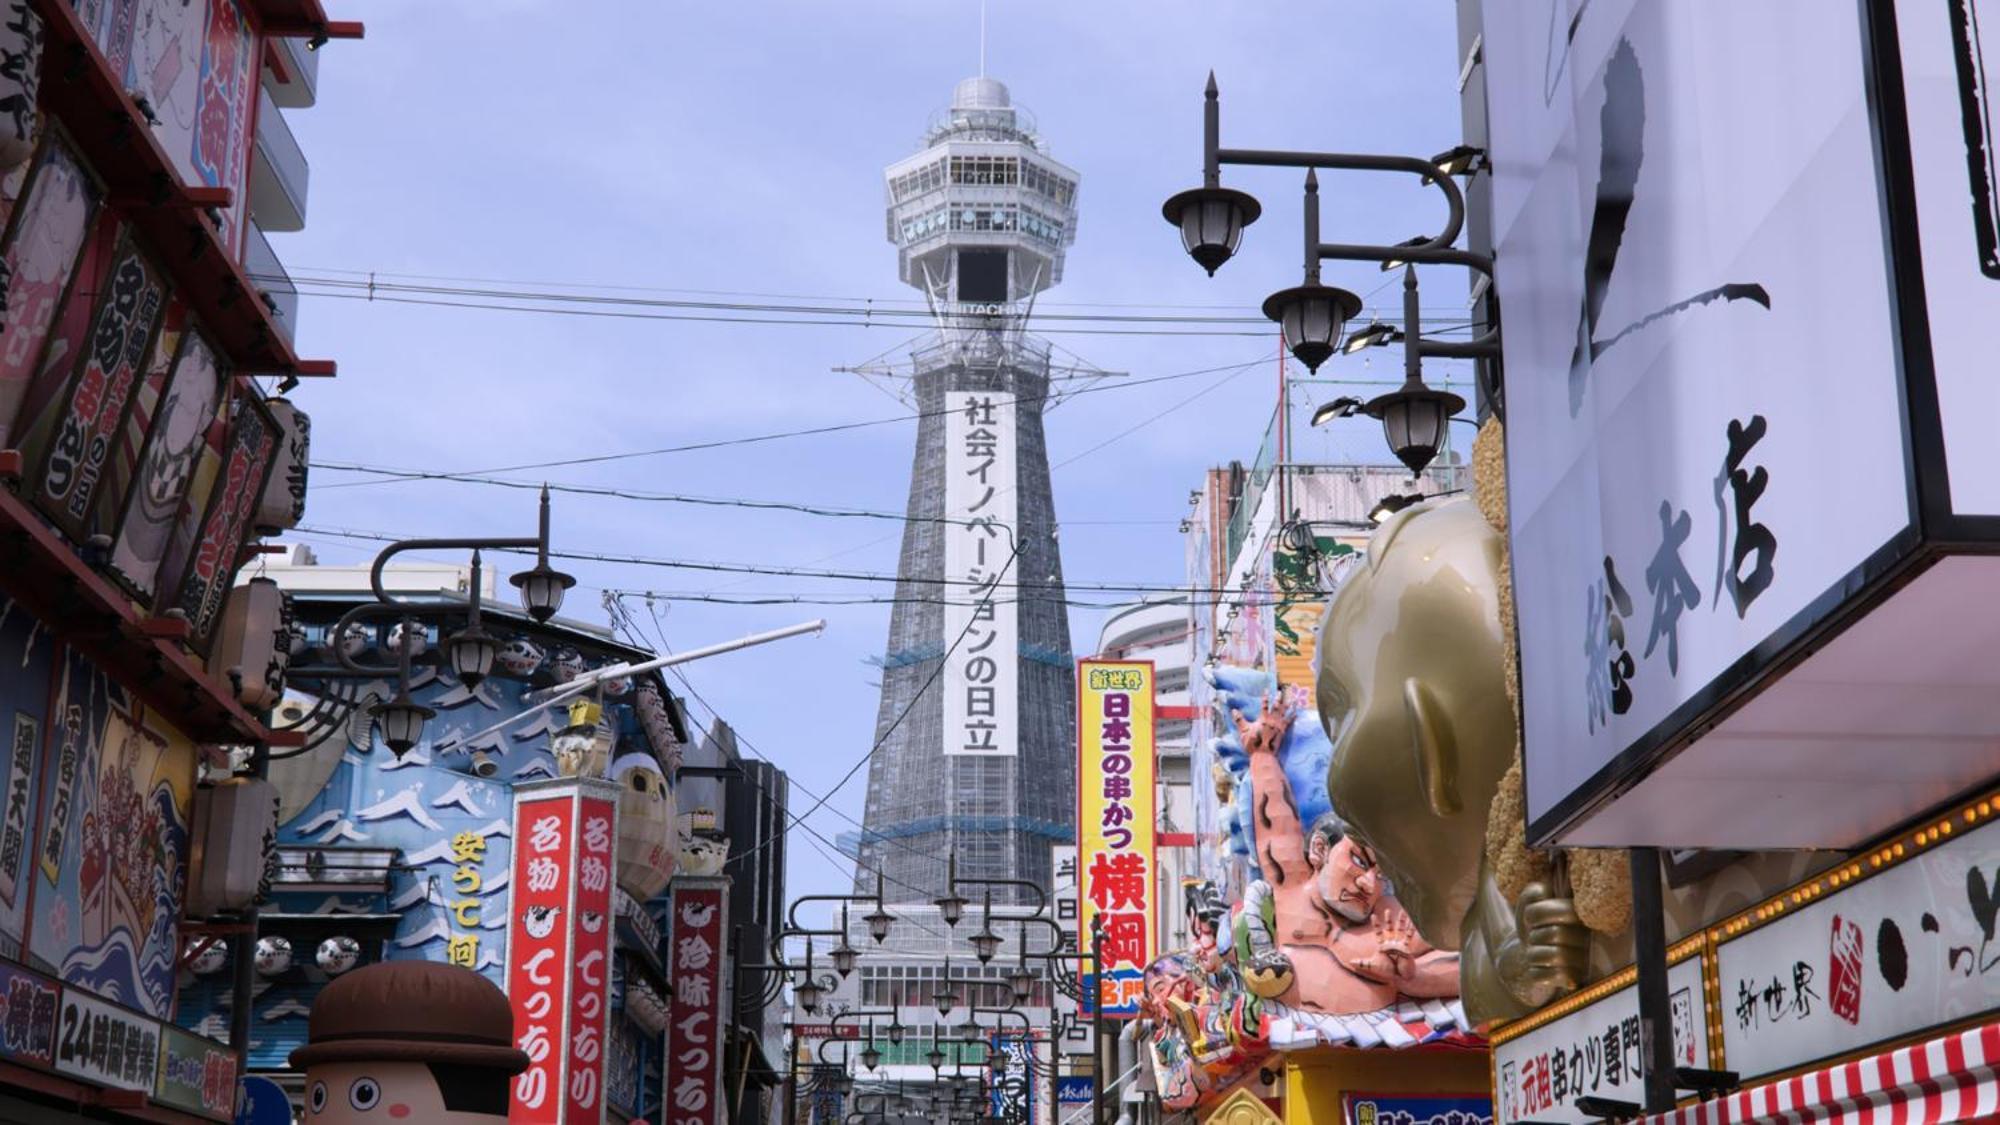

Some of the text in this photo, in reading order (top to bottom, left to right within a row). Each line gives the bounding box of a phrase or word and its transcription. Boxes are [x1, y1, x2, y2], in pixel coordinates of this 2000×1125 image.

[964, 396, 997, 752] 社会イノベーションの日立
[1090, 669, 1142, 690] 新世界
[1101, 693, 1133, 850] 日本一の串かつ
[515, 815, 562, 1109] 名物 てっちり
[571, 816, 609, 1110] 名物 てっちり
[1089, 852, 1147, 971] 横綱
[60, 1002, 157, 1088] 24時間営業
[674, 936, 713, 1125] 珍味てっち
[1736, 961, 1821, 1036] 新世界
